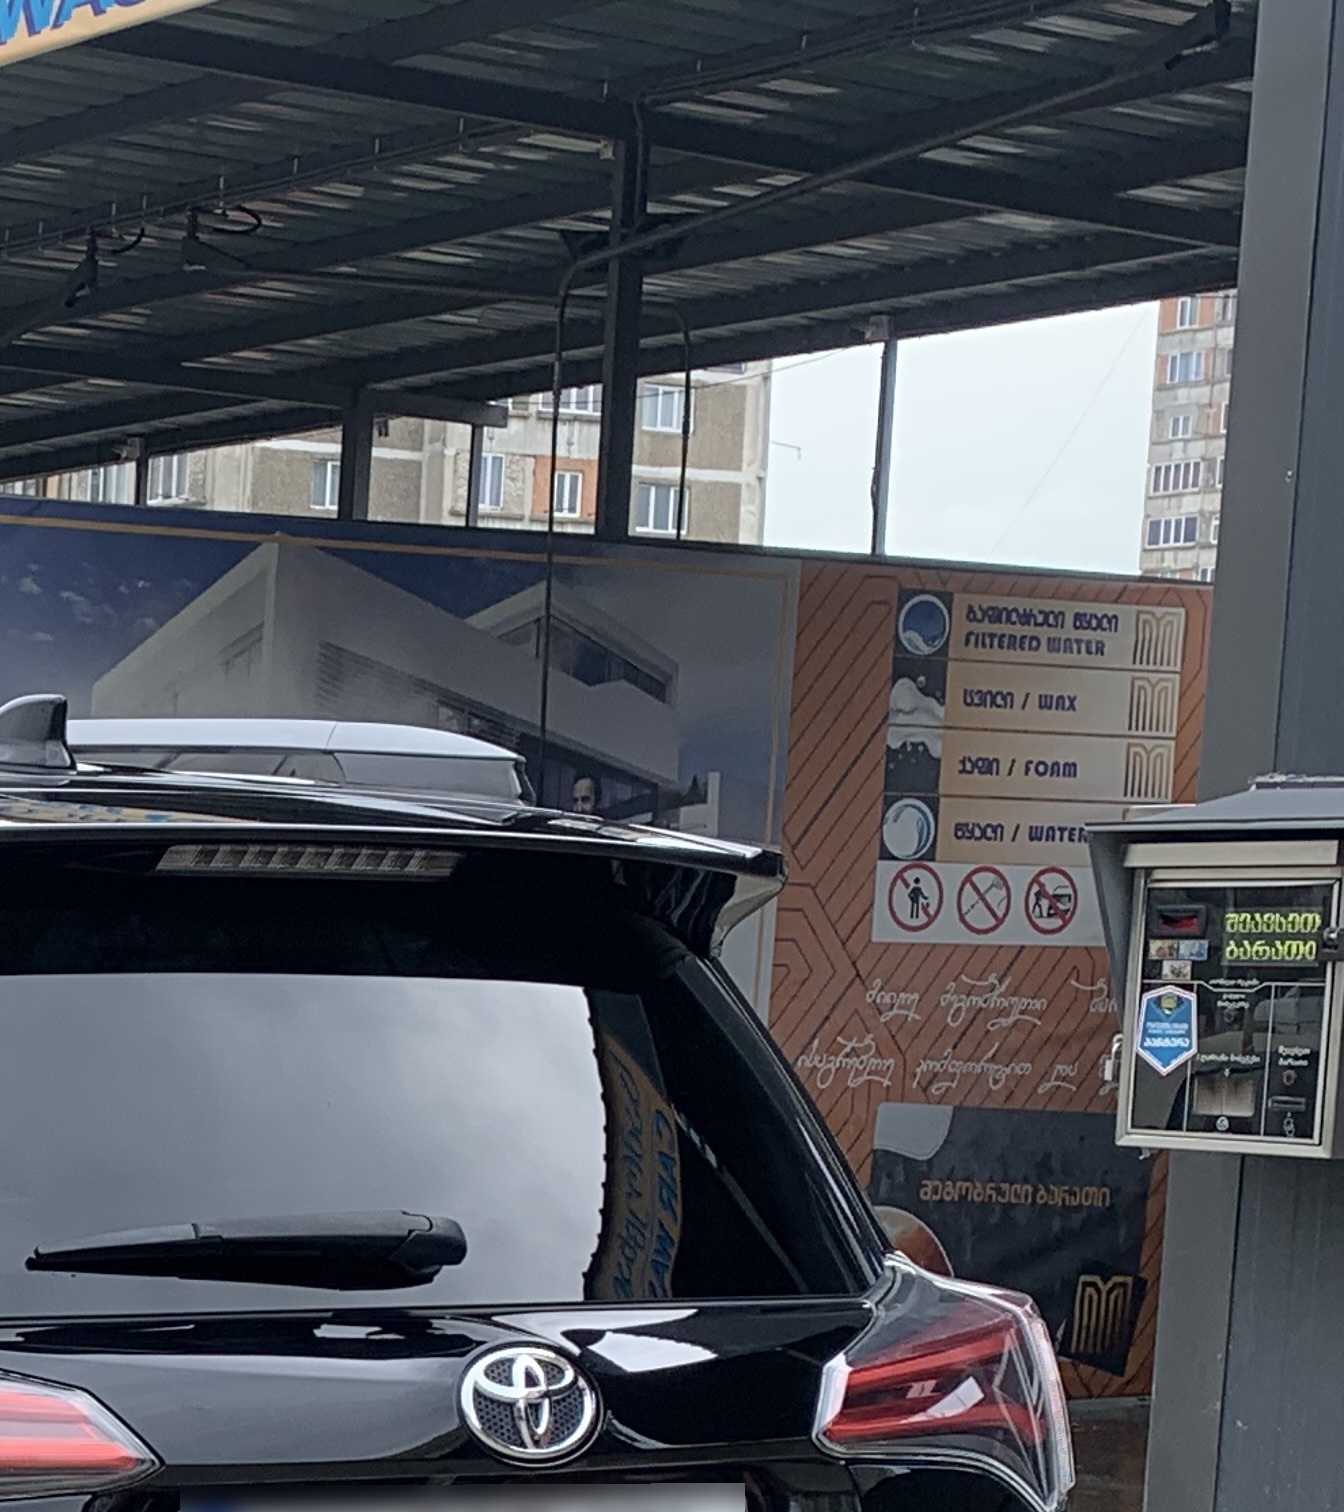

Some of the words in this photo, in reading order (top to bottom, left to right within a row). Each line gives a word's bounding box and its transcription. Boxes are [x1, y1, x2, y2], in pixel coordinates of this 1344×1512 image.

[1073, 611, 1119, 633] წყალი
[964, 631, 1041, 652] FILTERED
[1047, 637, 1105, 656] WATER
[1038, 693, 1078, 712] WAX
[1024, 760, 1078, 778] FOAM
[953, 822, 1005, 842] წყალი
[1225, 940, 1317, 961] ბარათი
[1037, 1184, 1111, 1207] ბარათი
